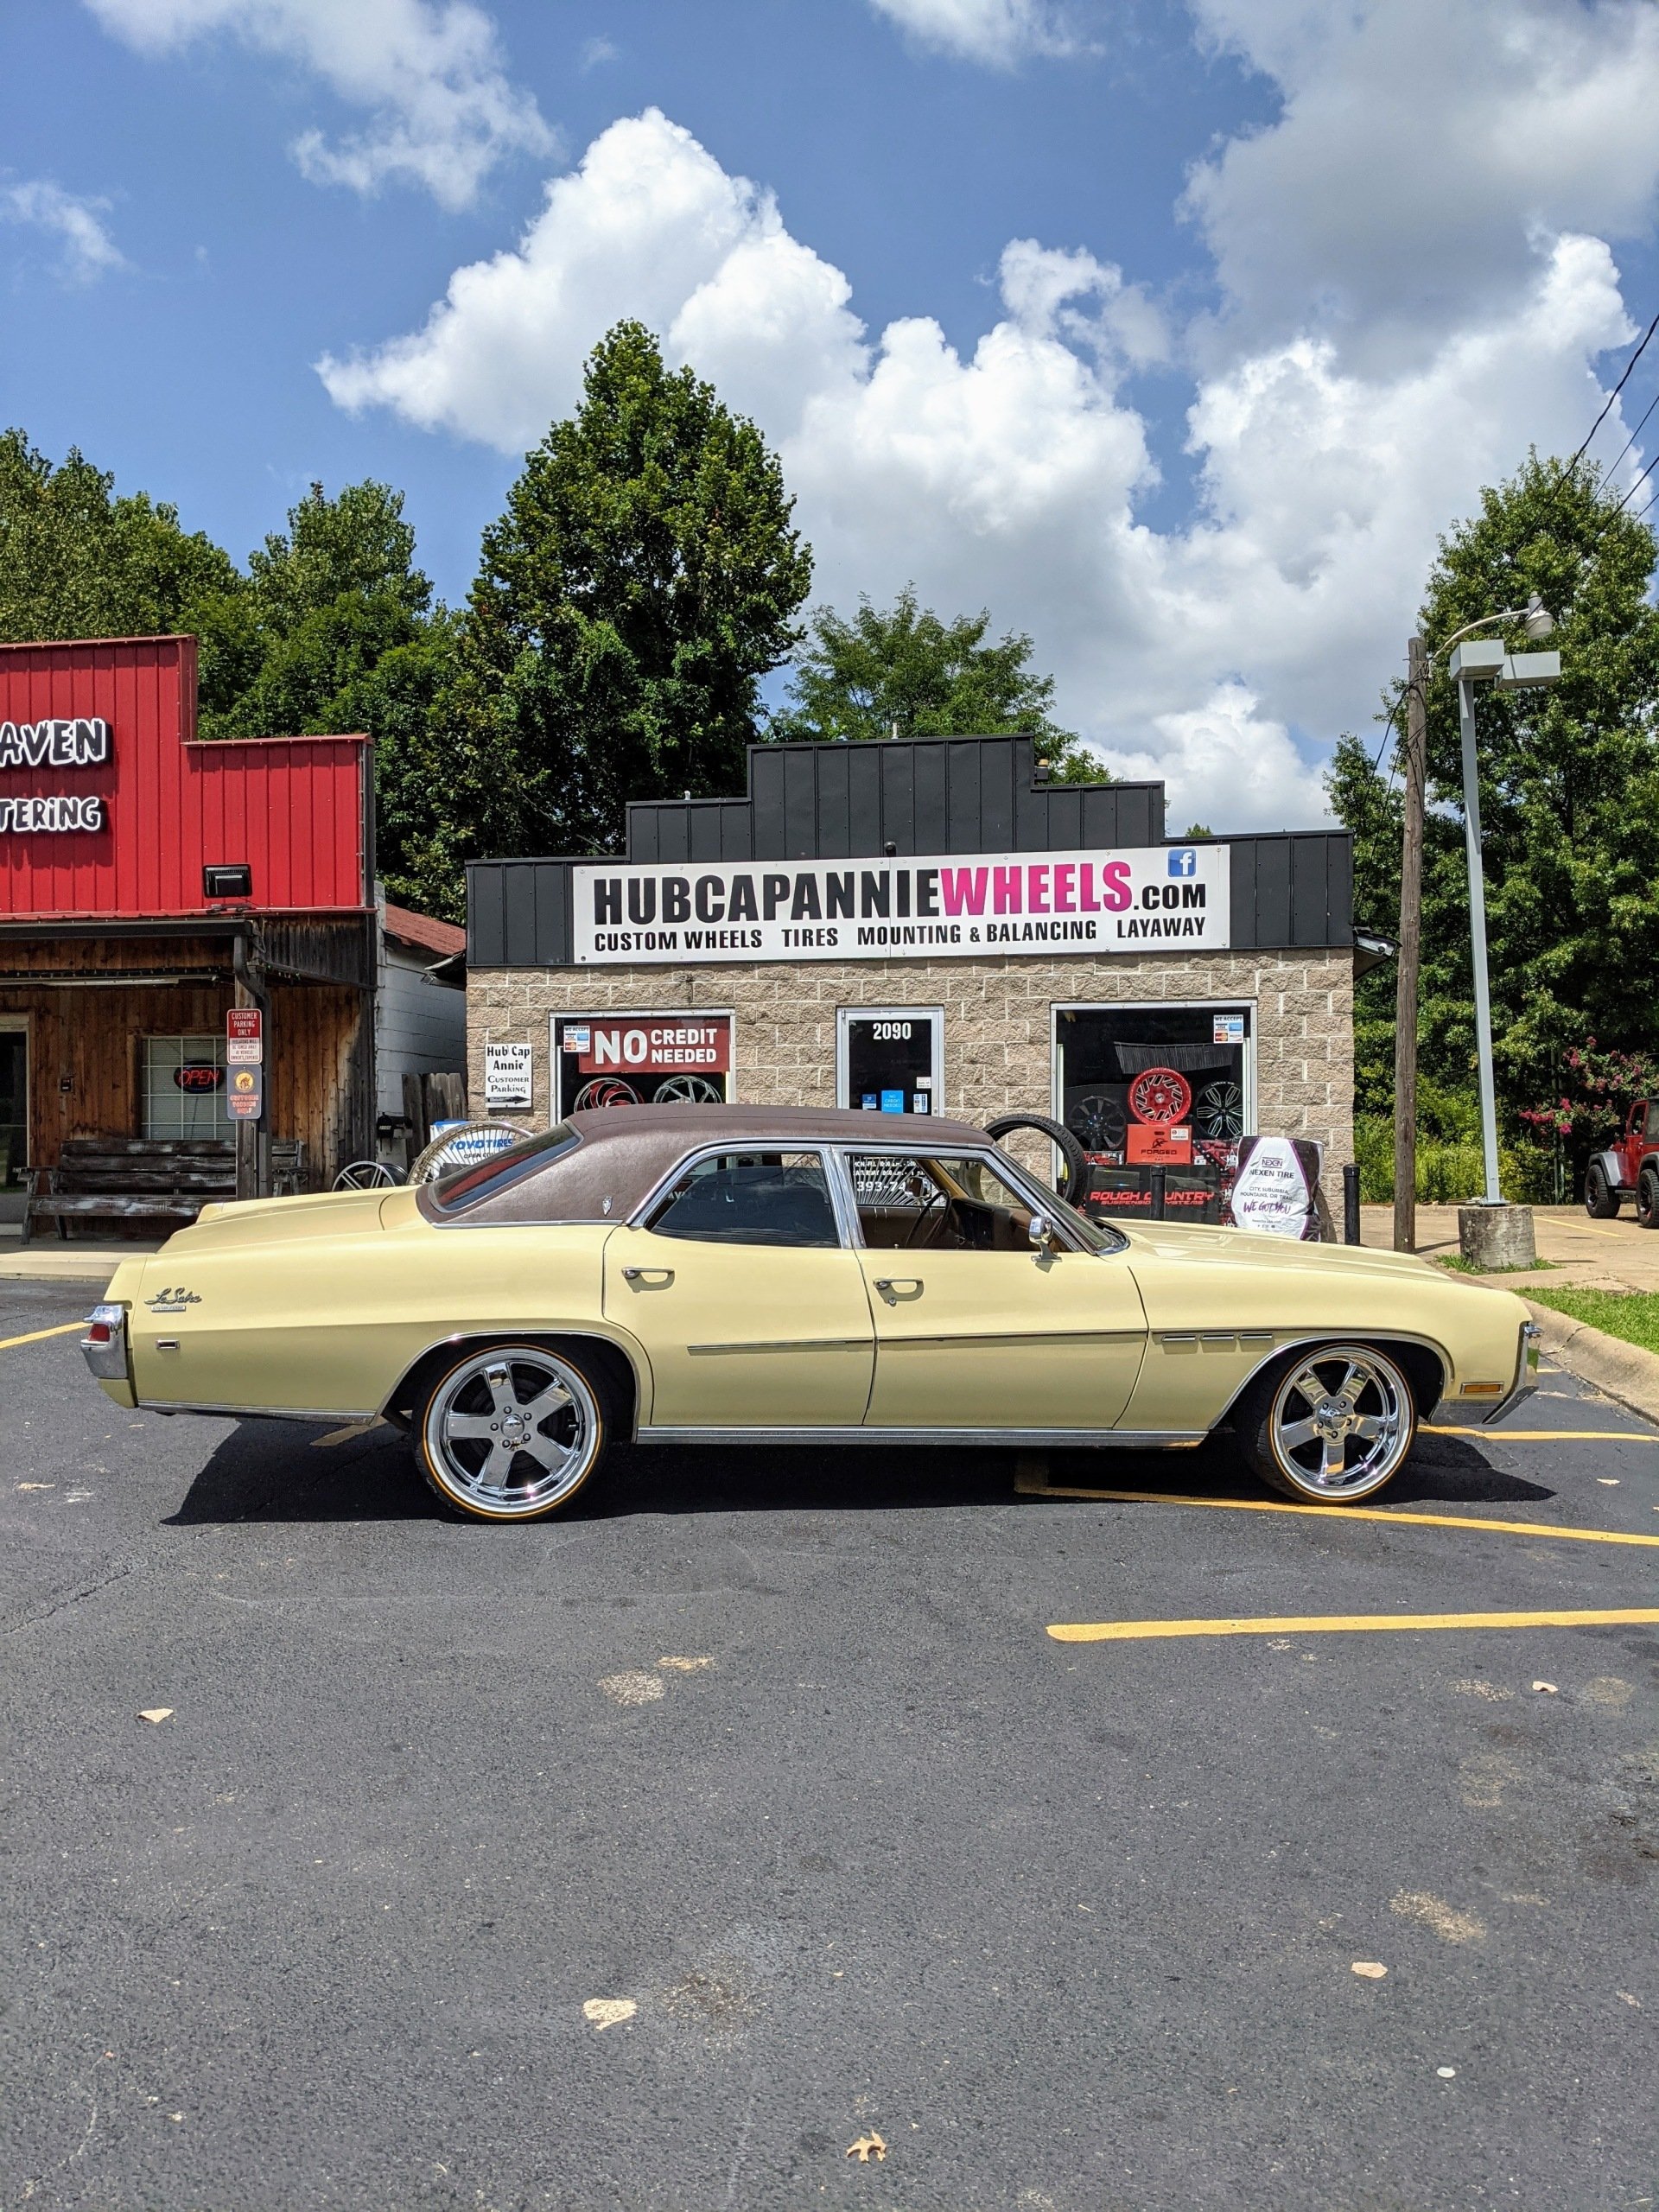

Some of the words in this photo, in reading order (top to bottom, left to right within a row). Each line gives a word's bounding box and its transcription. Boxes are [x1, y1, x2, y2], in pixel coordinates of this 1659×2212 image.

[594, 931, 678, 951] CUSTOM
[684, 929, 762, 949] WHEELS
[781, 927, 839, 947] TIRES
[857, 924, 961, 946] MOUNTING
[969, 926, 981, 943] &
[987, 919, 1096, 943] BALANCING
[1116, 916, 1206, 938] LAYAWAY
[231, 1012, 257, 1020] CUSTOMER
[233, 1020, 256, 1028] PARKING
[873, 1022, 912, 1040] 2090
[486, 1046, 508, 1057] Hub
[512, 1046, 531, 1059] Cap
[594, 1029, 648, 1065] NO
[651, 1028, 718, 1046] CREDIT
[652, 1048, 717, 1064] NEEDED
[493, 1059, 524, 1071] Annie
[178, 1069, 219, 1086] OPEN
[1249, 1168, 1274, 1177] NEXEN
[1275, 1170, 1295, 1179] TIRE
[857, 1181, 906, 1192] 393-74
[1090, 1191, 1141, 1201] ROUGH
[1142, 1191, 1215, 1201] CUNTRY
